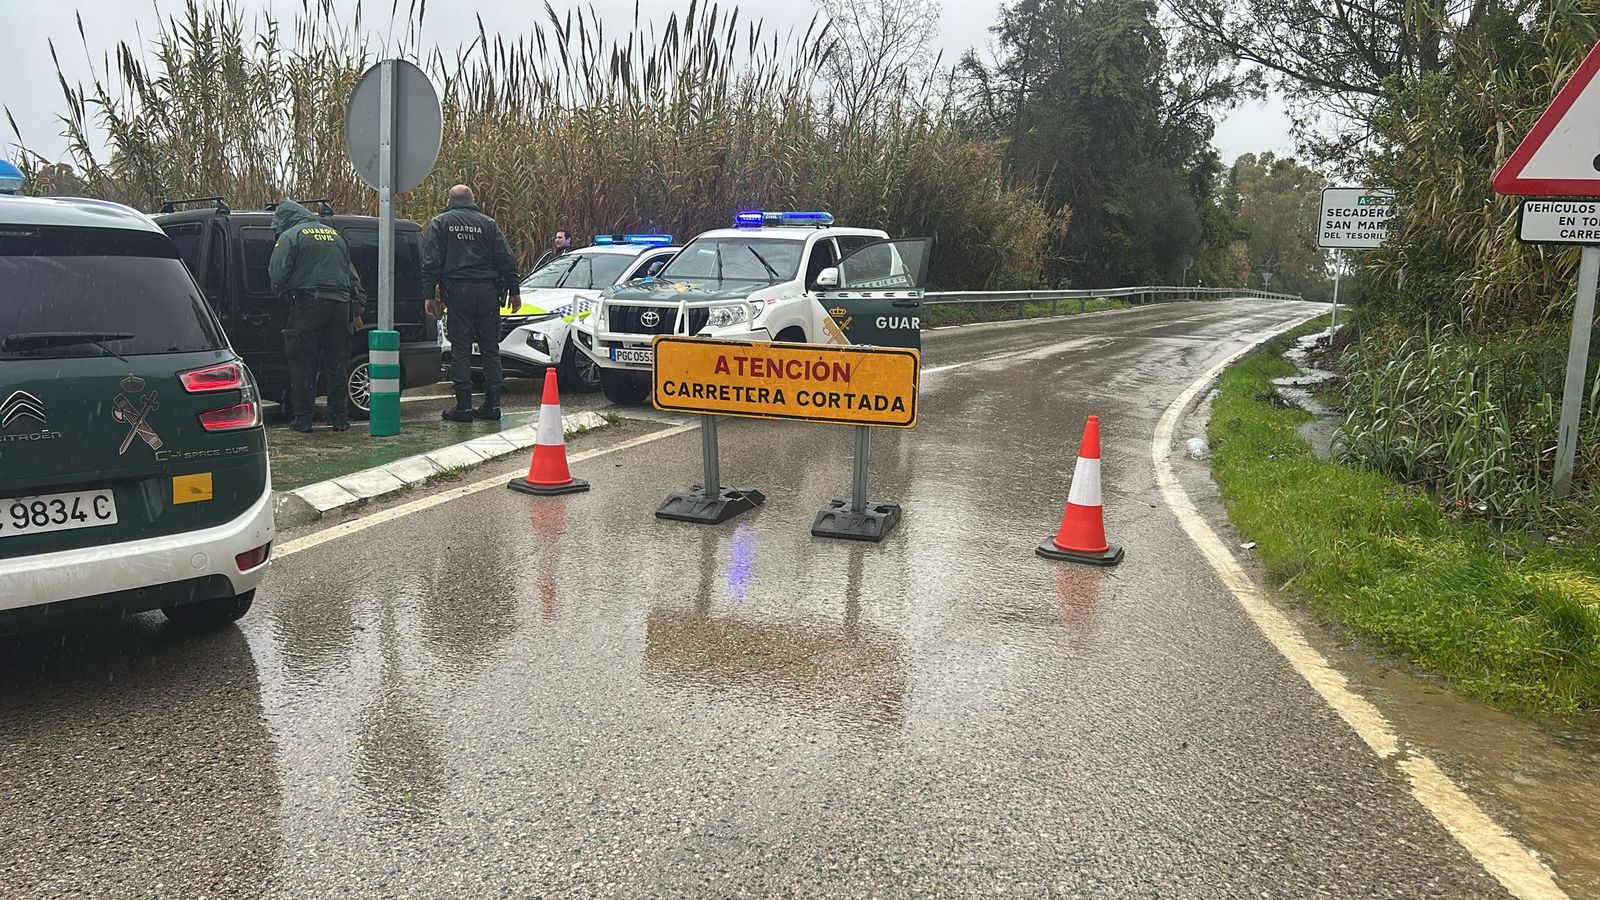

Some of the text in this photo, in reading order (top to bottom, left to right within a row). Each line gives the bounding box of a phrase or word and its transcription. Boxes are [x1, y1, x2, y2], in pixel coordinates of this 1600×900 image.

[1325, 221, 1351, 230] SAN
[1559, 217, 1600, 227] EN TO
[302, 228, 338, 236] GUARDIA
[449, 225, 482, 234] GUARDIA
[457, 233, 476, 241] CIVIL
[875, 316, 920, 330] GUAR
[616, 350, 633, 361] PGC
[714, 355, 851, 383] ATENCIÓN
[663, 380, 906, 413] CARRETERA CORTADA
[0, 429, 62, 442] ITROËN
[9, 496, 88, 530] 9834
[93, 494, 112, 520] C
